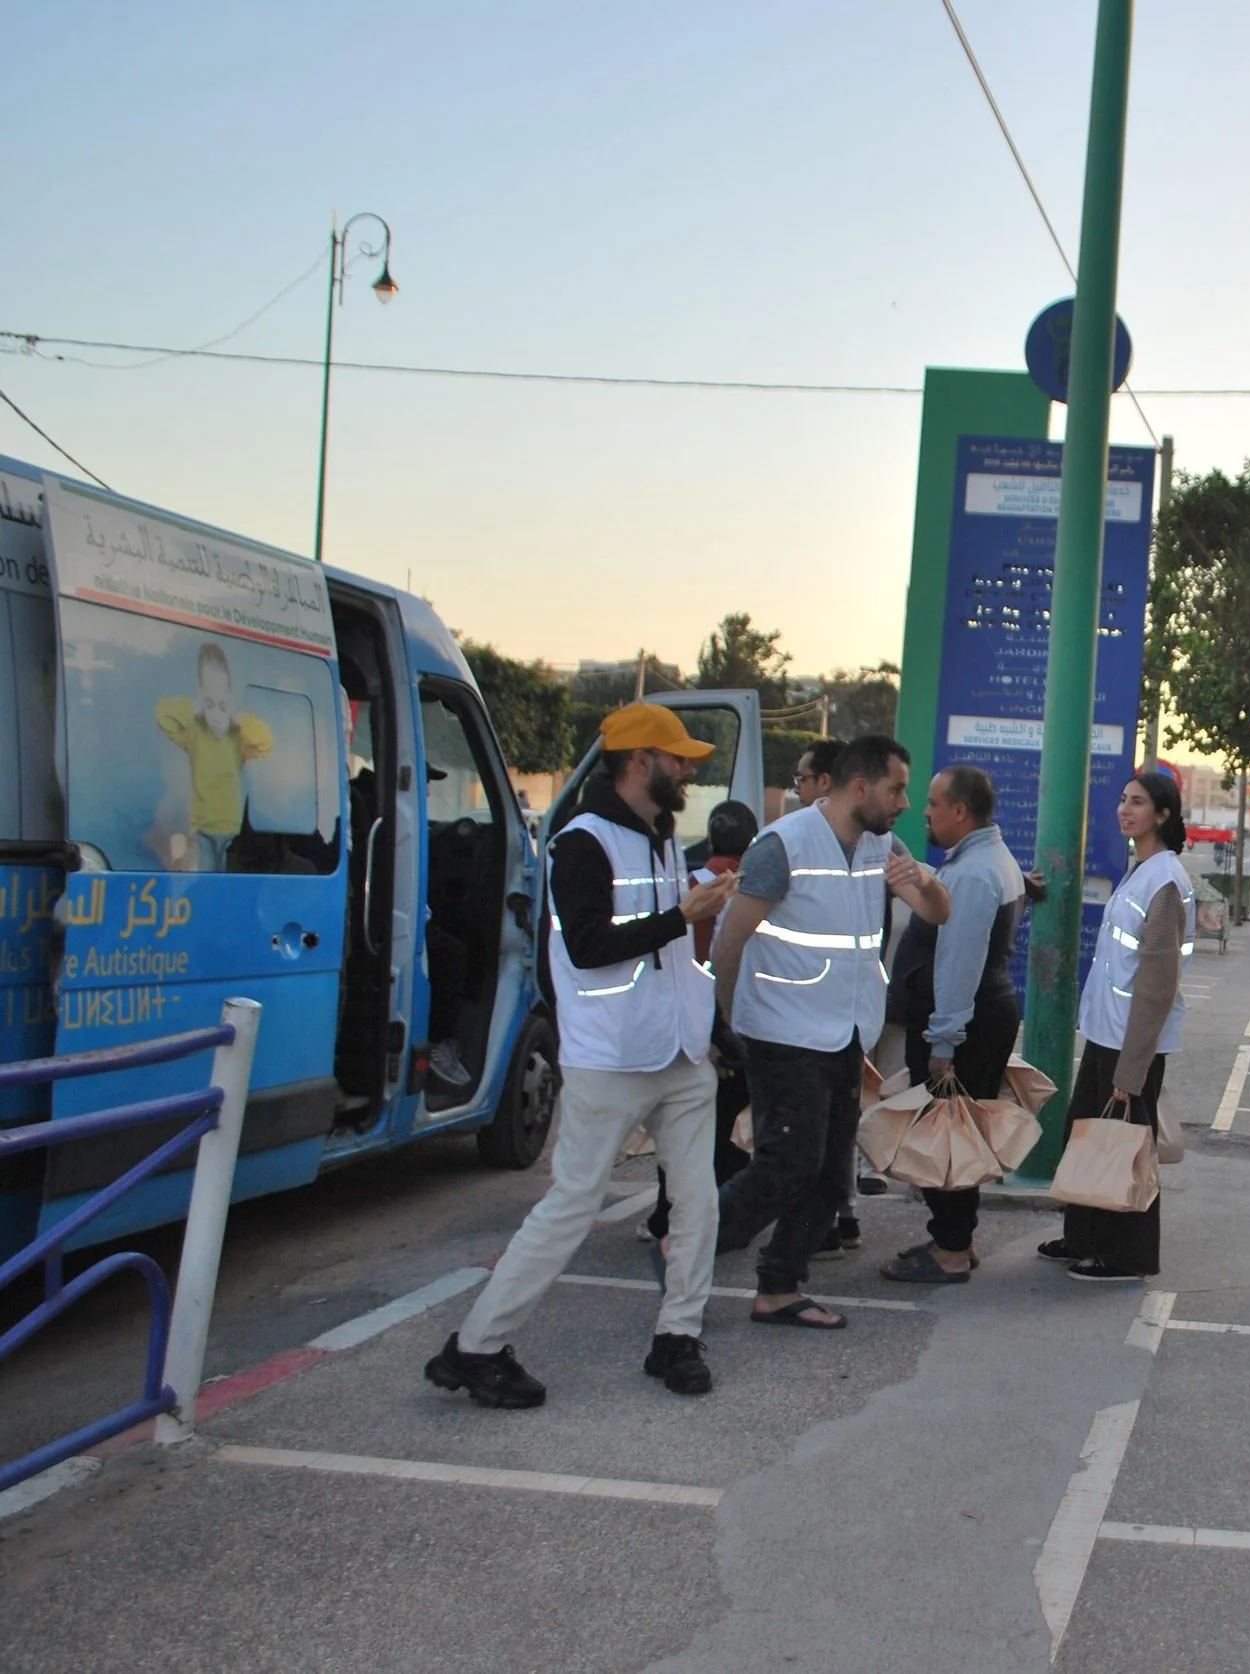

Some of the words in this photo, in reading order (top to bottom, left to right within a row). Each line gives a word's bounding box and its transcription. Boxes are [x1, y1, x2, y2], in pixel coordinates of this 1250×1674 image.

[84, 514, 153, 568] البشرية
[963, 736, 1000, 744] SERVICES
[119, 877, 192, 939] مركز
[84, 946, 189, 982] Autistique
